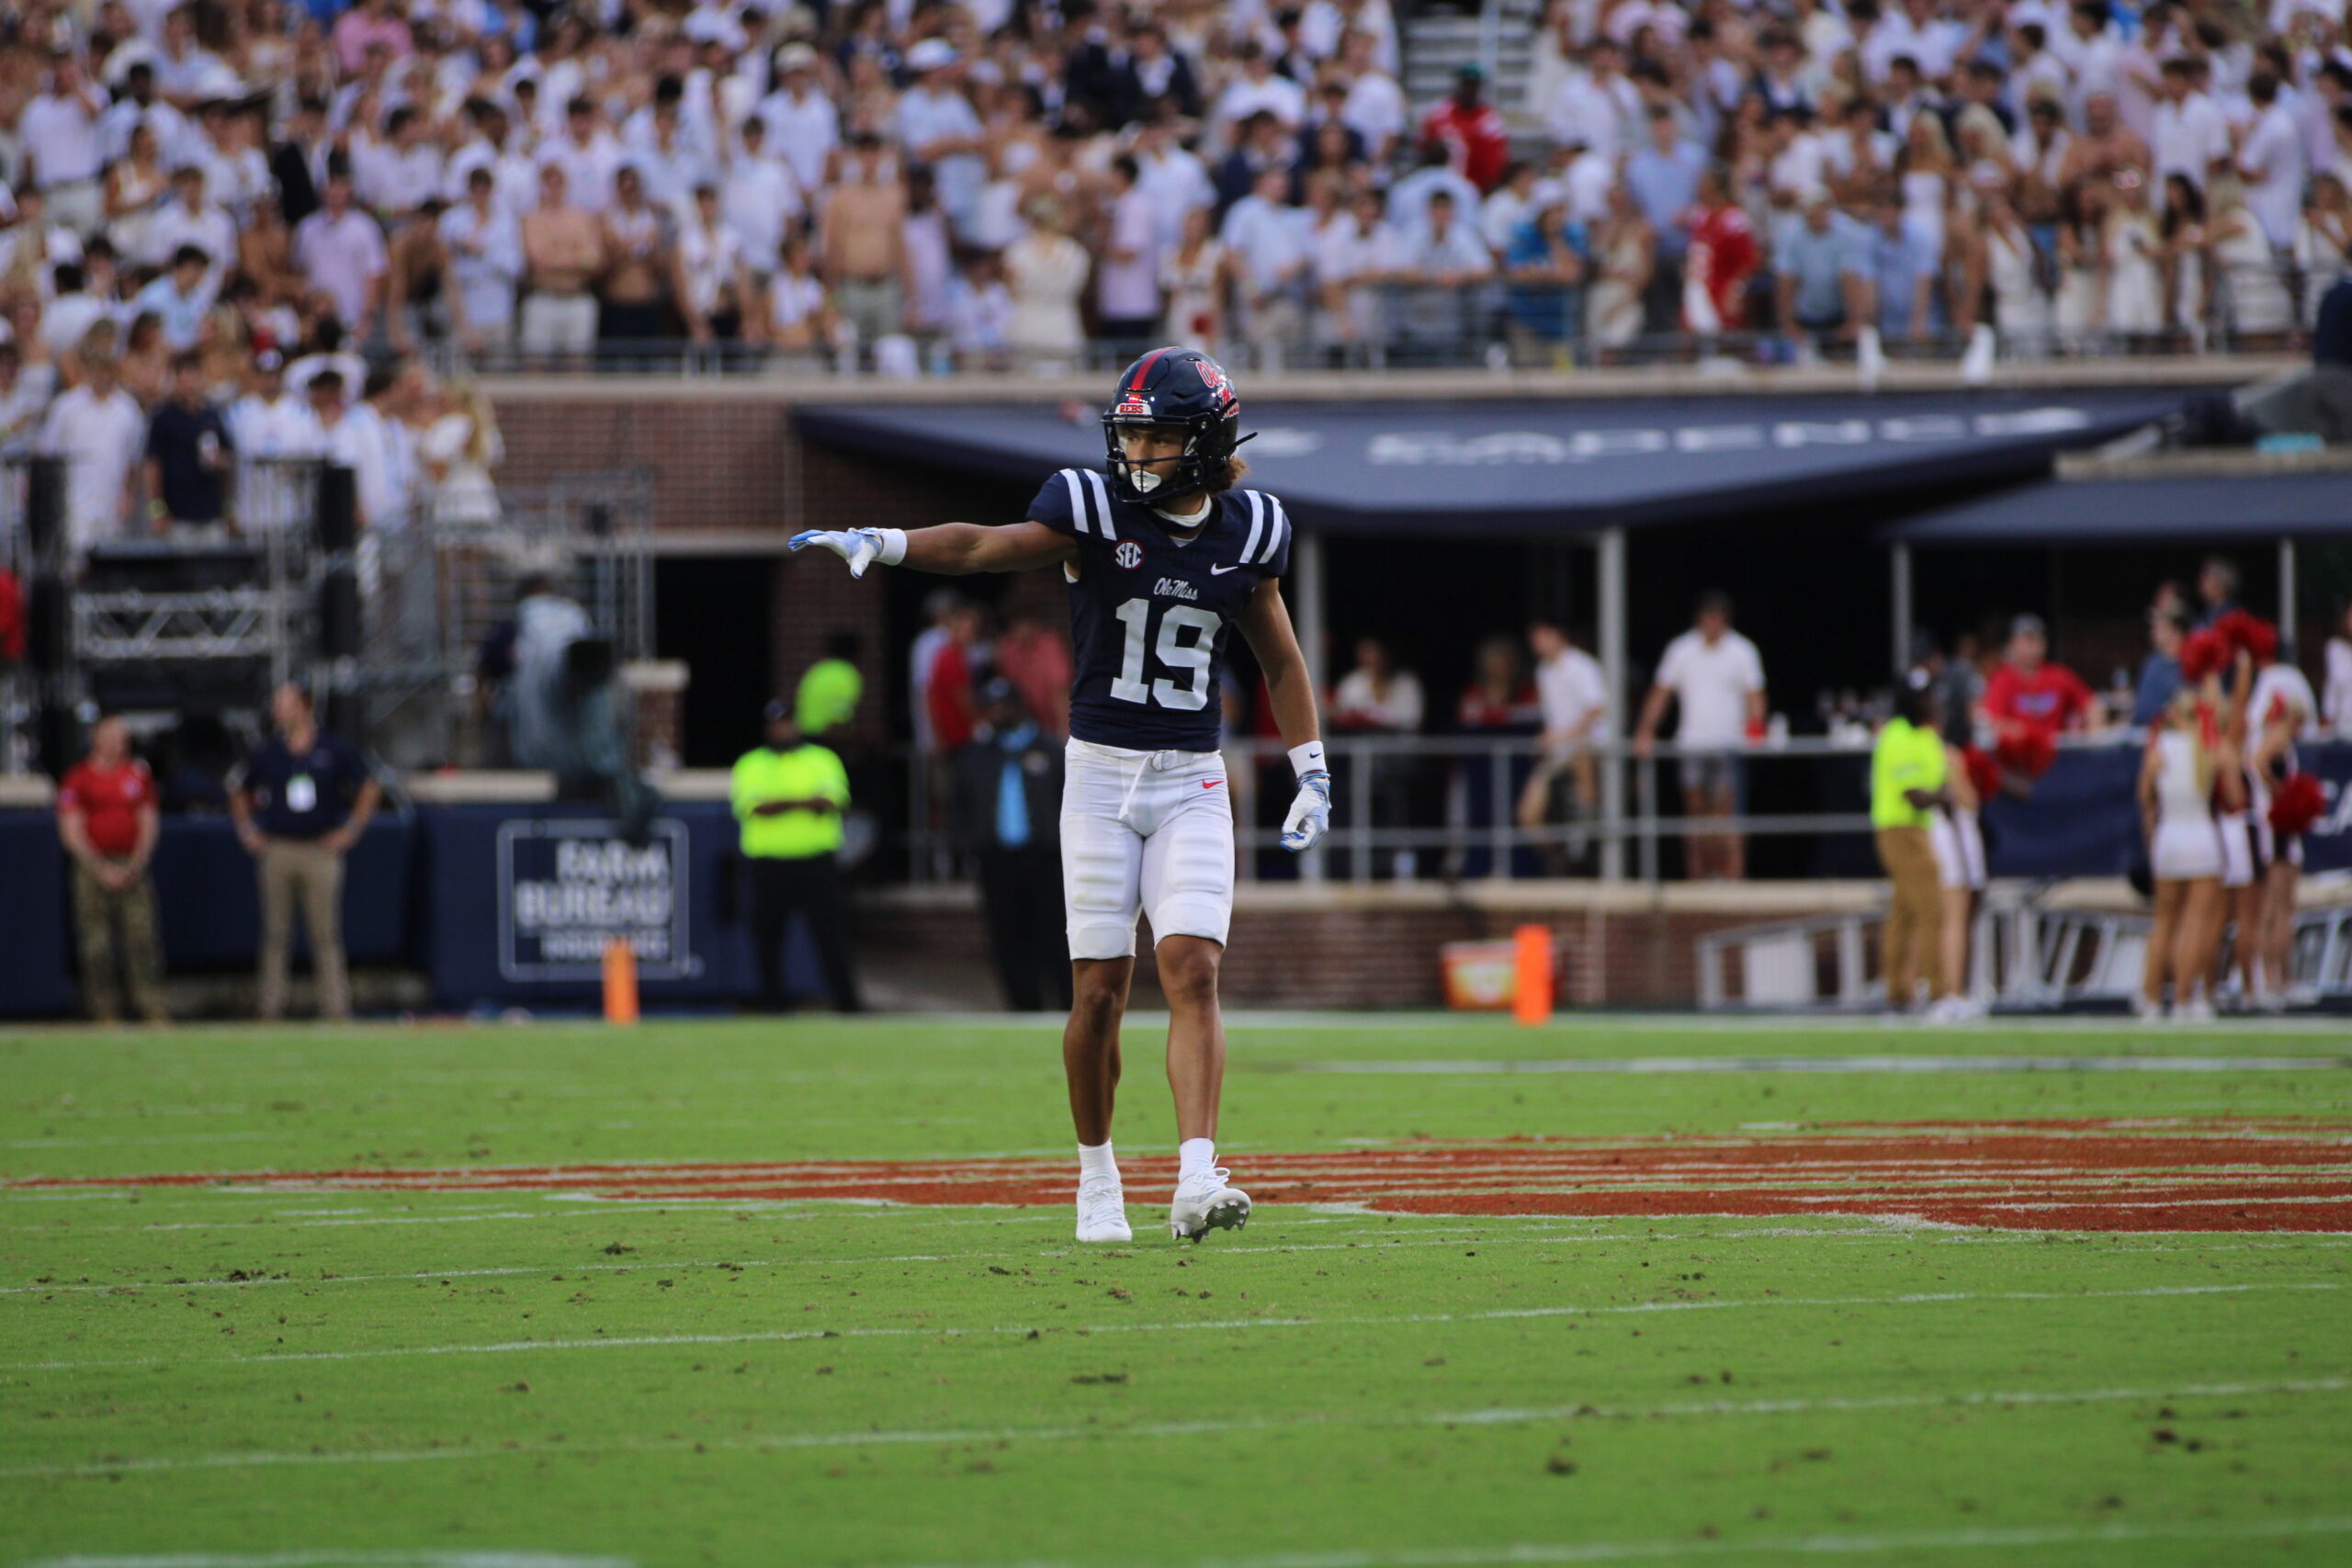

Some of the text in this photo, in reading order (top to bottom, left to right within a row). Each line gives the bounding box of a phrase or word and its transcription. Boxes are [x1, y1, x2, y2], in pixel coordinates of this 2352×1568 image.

[1119, 404, 1144, 414] REBS
[1114, 542, 1142, 569] SEC
[1153, 577, 1199, 602] Ole Miss
[1110, 598, 1223, 711] 19
[556, 840, 671, 879] FARM
[515, 879, 671, 926] BUREAU
